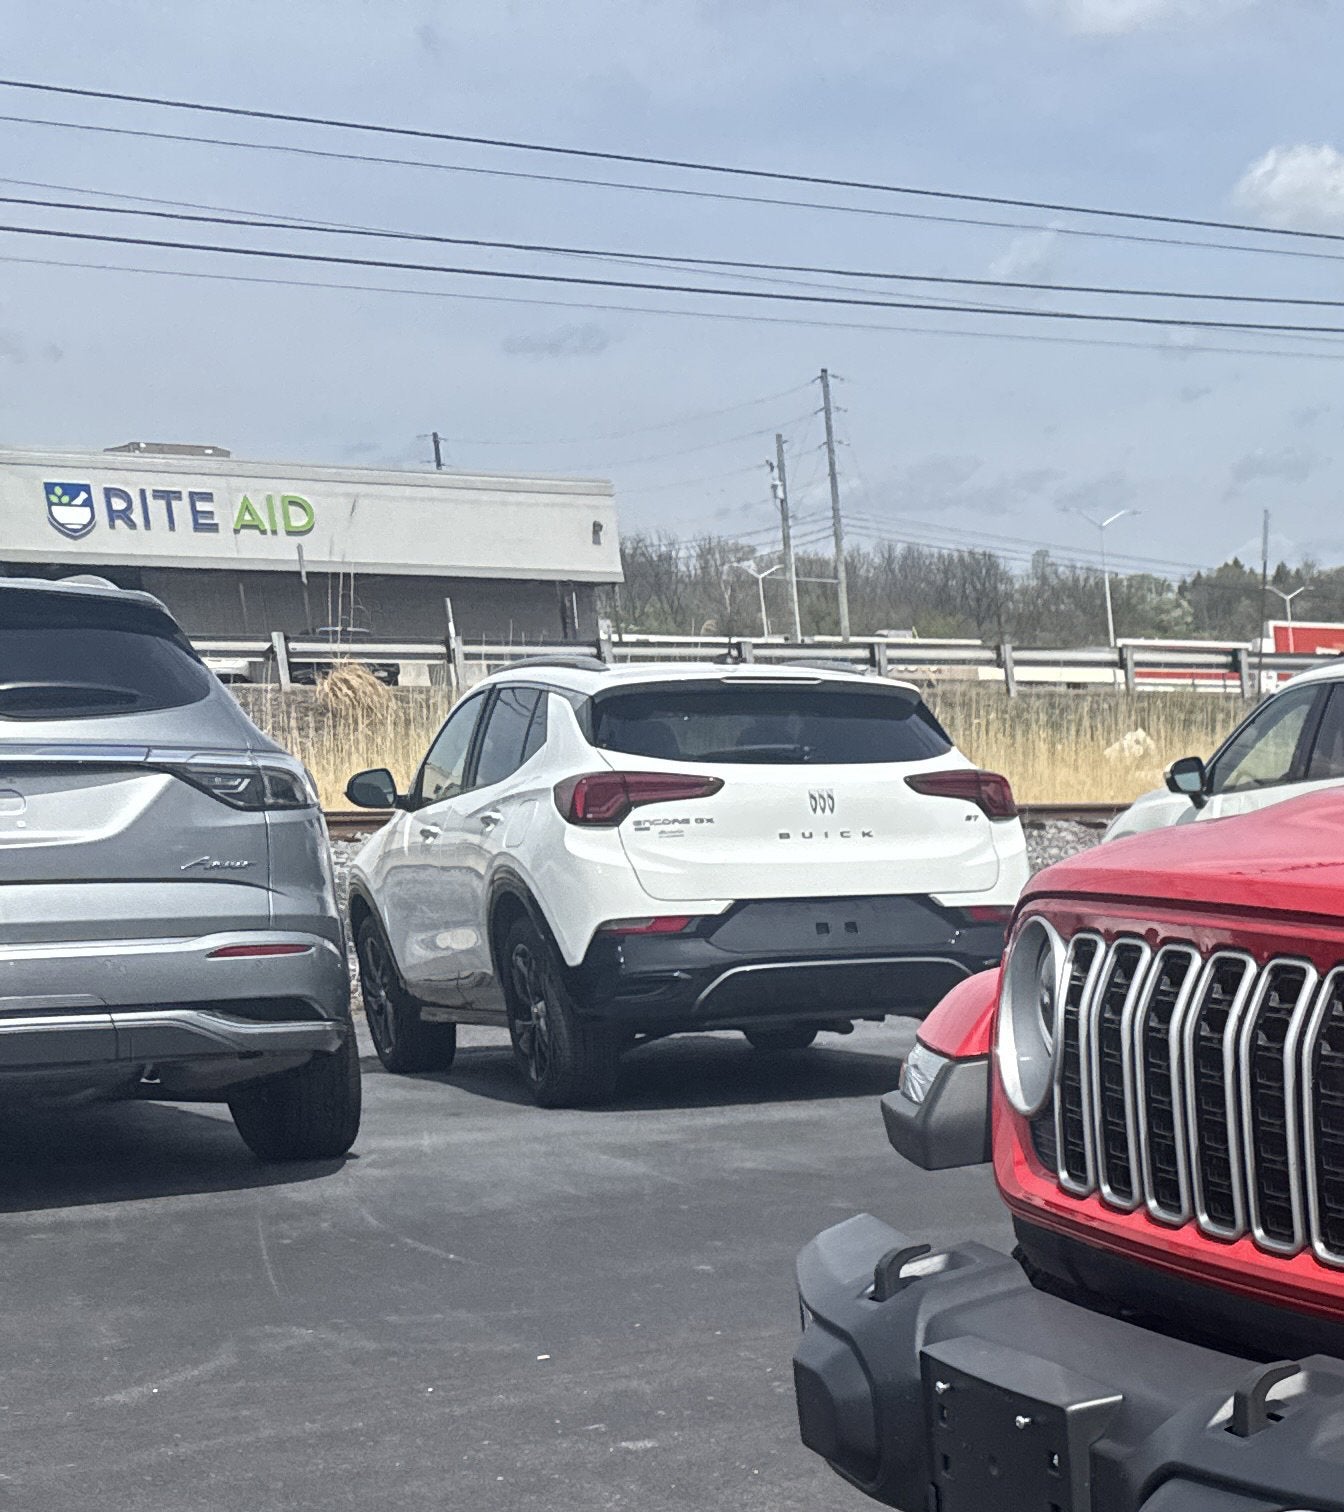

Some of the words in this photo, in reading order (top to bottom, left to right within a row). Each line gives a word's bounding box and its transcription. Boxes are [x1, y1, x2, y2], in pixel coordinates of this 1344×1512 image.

[103, 486, 220, 533] RITE
[232, 494, 316, 537] AID
[779, 830, 874, 839] BUICK
